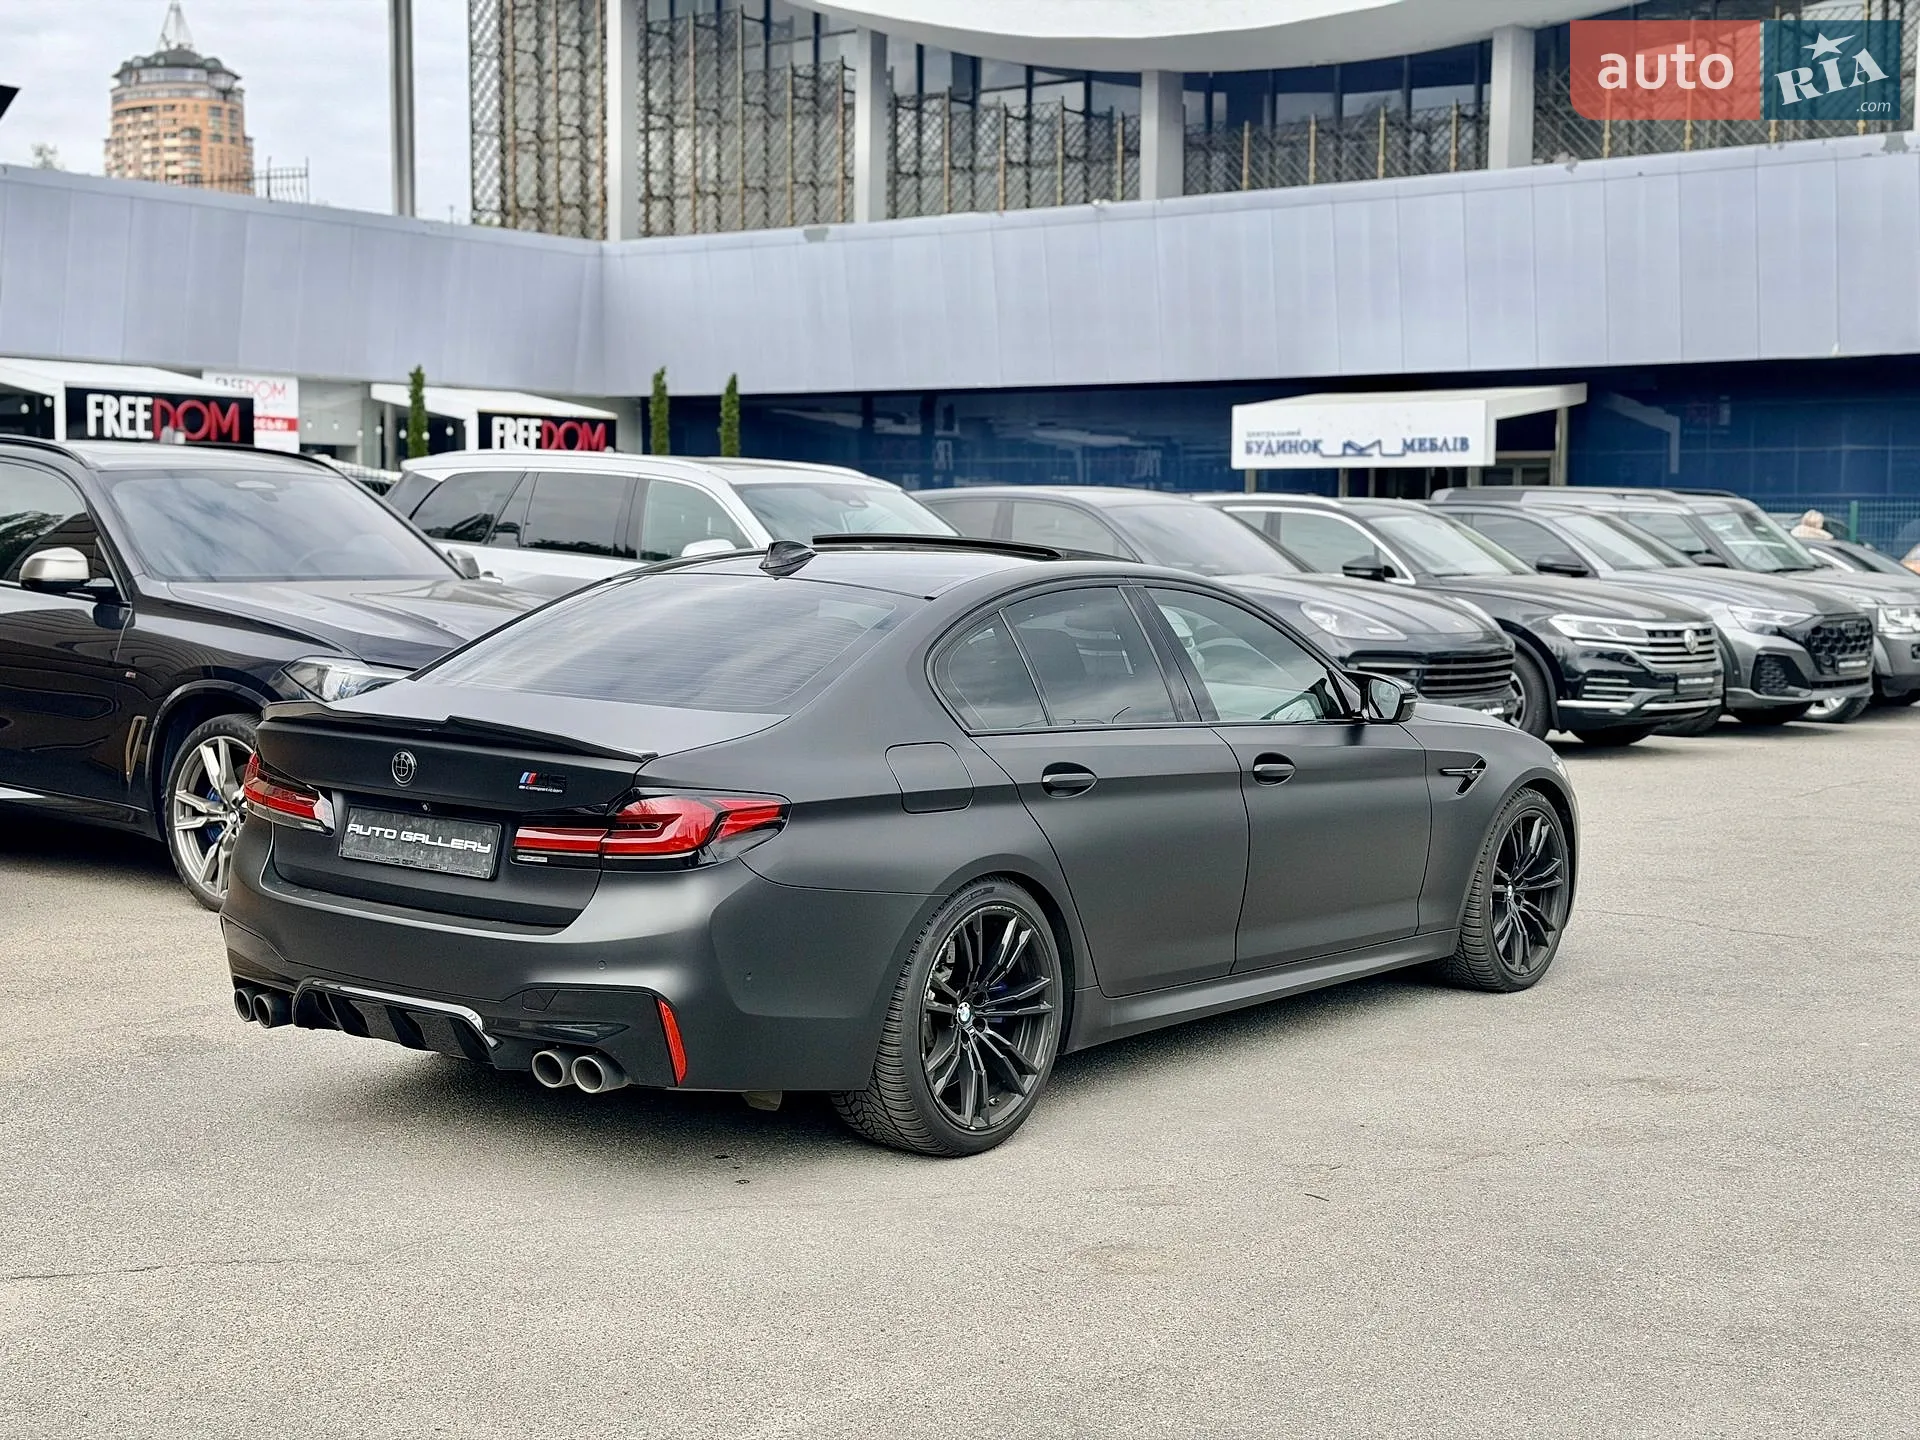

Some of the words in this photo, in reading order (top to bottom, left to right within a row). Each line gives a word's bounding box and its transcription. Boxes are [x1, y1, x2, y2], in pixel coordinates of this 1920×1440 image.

[87, 393, 240, 443] FREEDOM
[1245, 439, 1323, 457] БУДИНОК
[1402, 437, 1469, 452] МЕБЛІВ
[347, 823, 397, 840] AUTO
[400, 830, 491, 853] GALLERY
